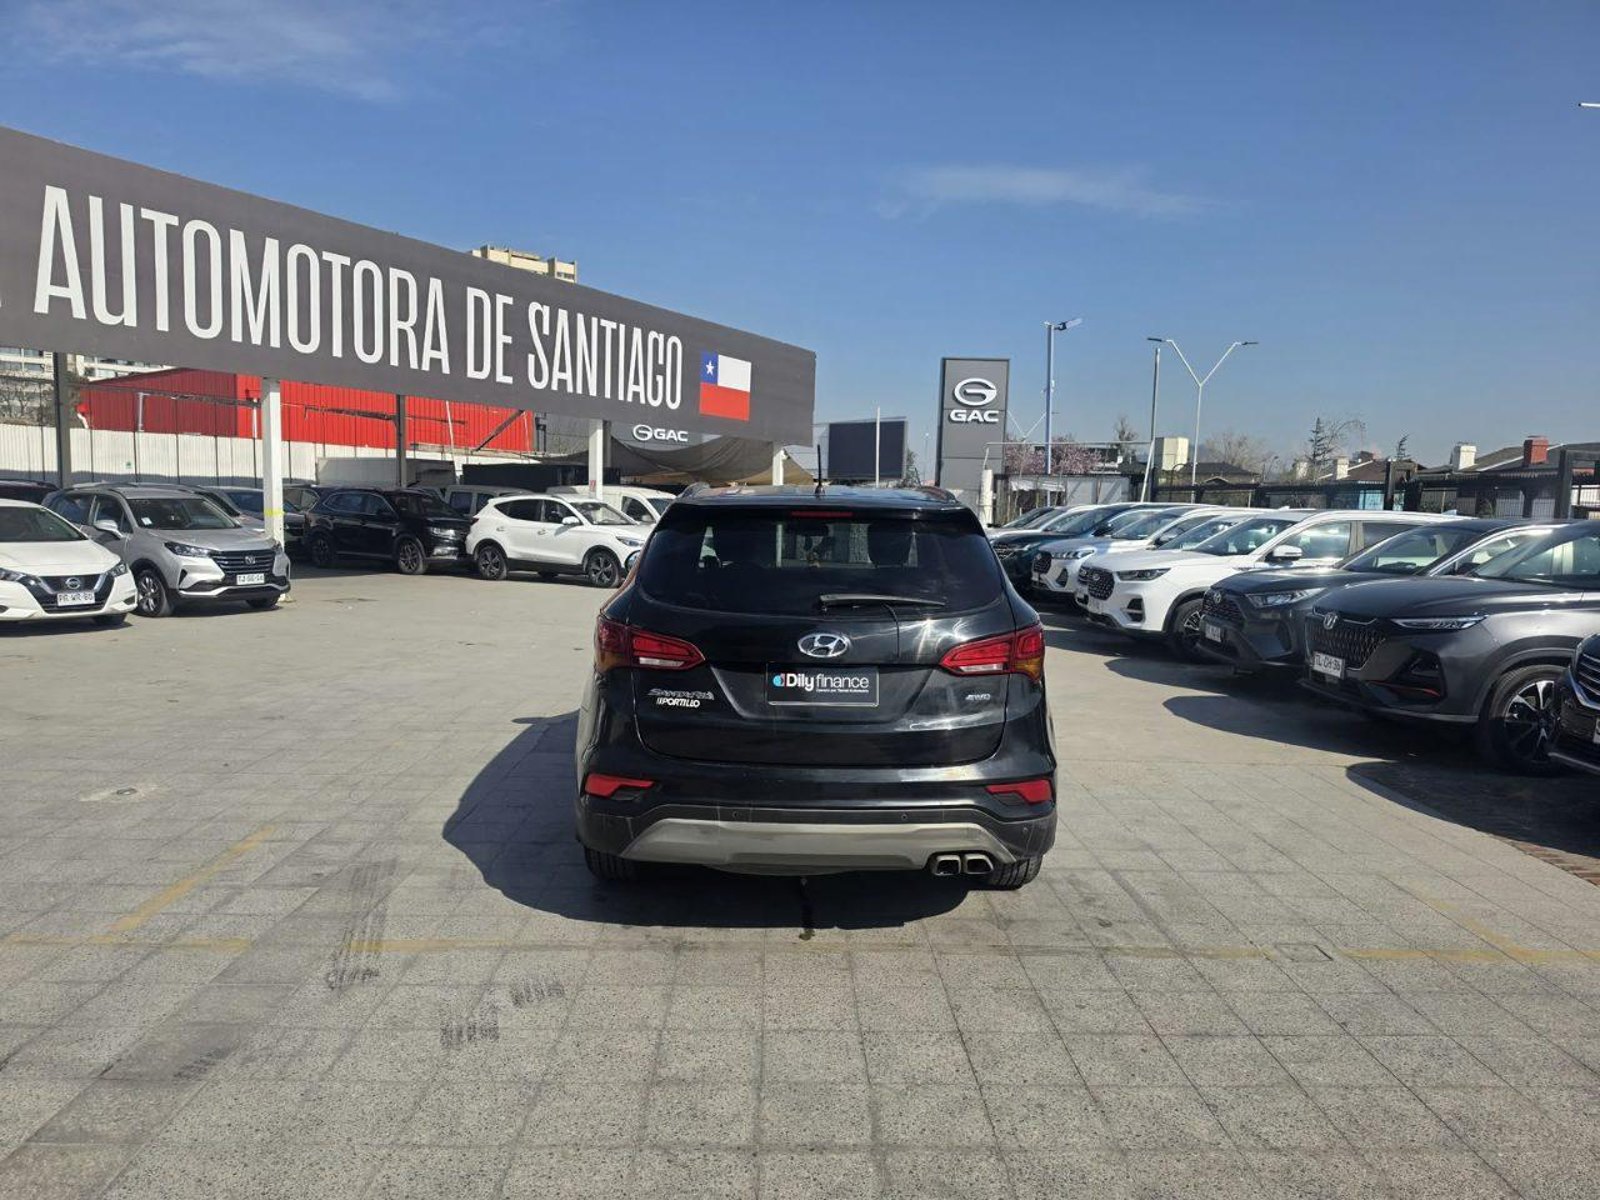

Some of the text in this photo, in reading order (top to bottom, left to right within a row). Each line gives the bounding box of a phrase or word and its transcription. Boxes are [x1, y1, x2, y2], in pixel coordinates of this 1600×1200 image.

[34, 185, 683, 410] AUTOMOTORA DE SANTIAGO
[950, 409, 999, 422] GAC
[653, 428, 688, 442] GAC
